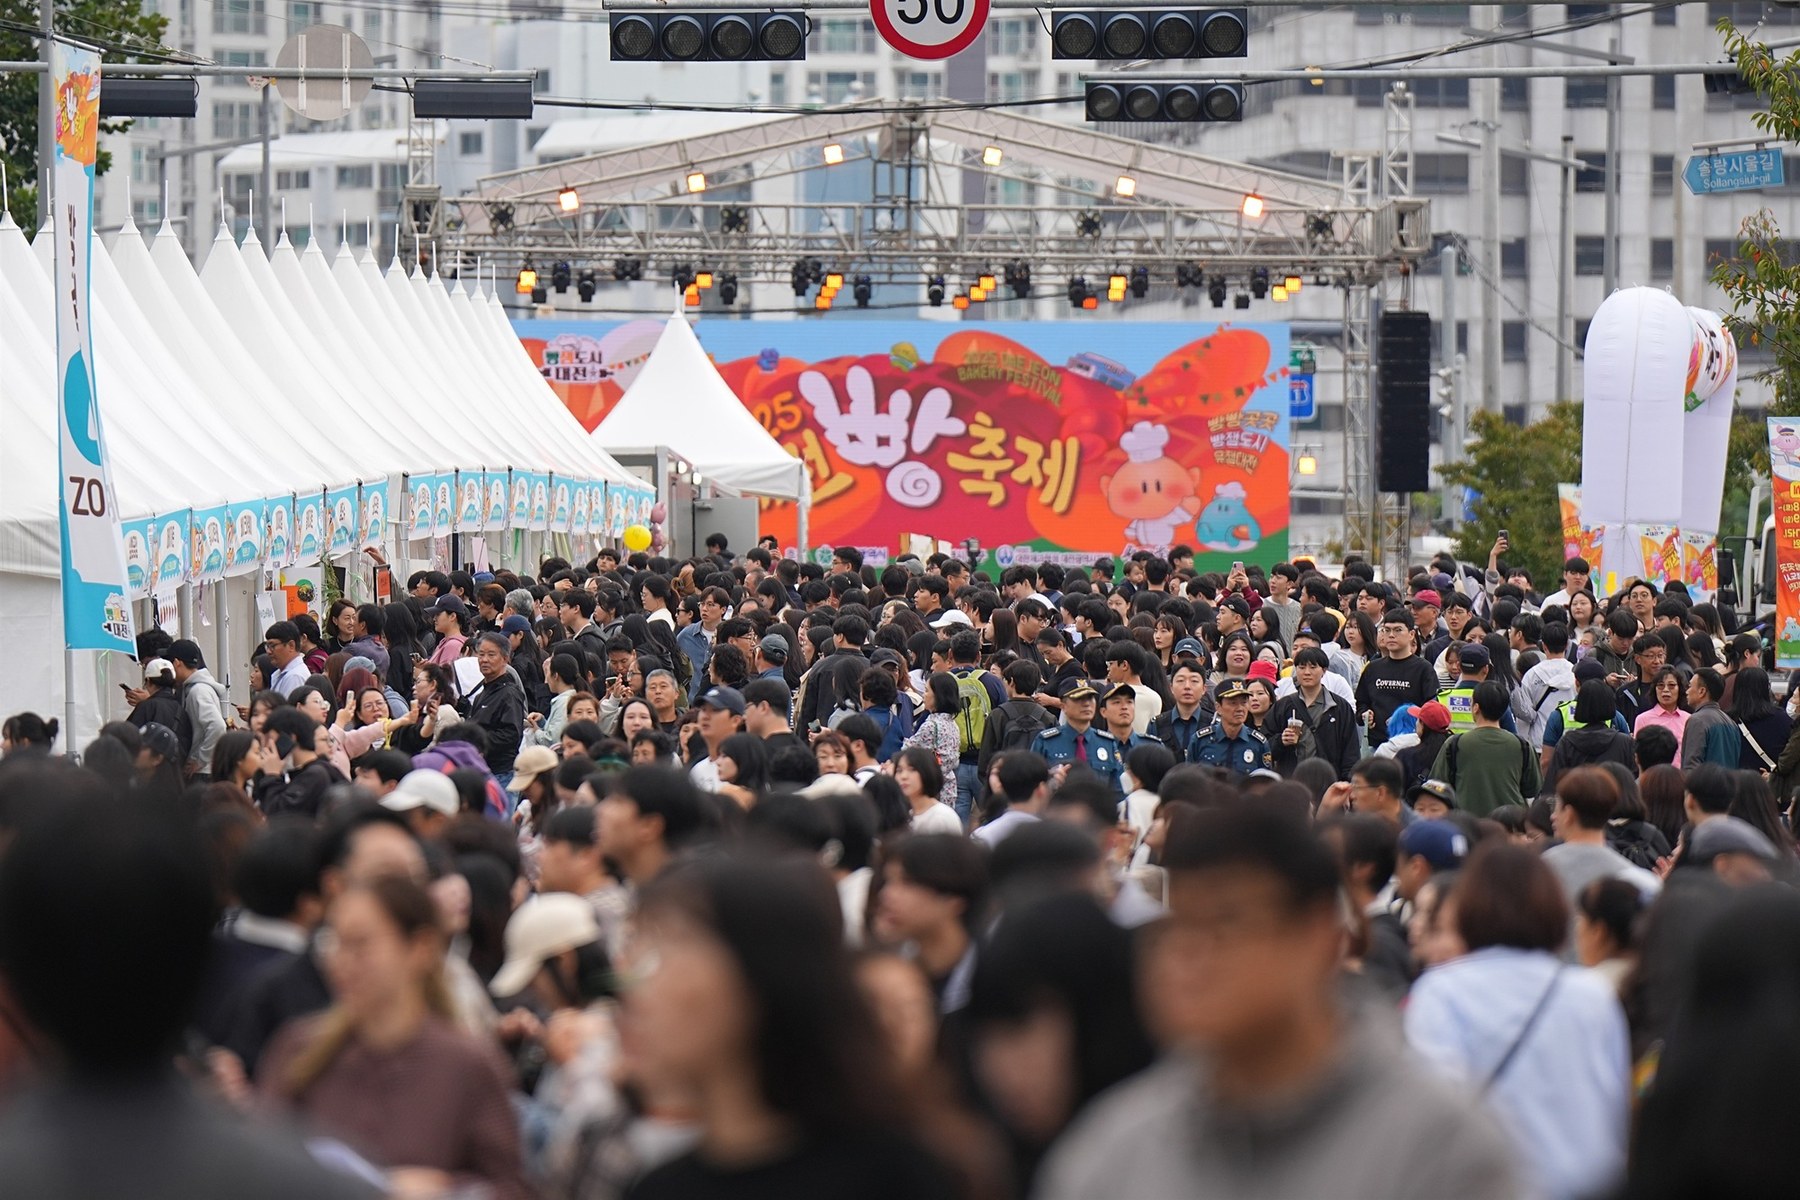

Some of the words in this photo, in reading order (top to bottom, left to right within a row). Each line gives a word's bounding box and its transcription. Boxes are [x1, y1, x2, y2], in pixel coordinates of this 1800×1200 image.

[897, 0, 965, 25] 50
[1697, 152, 1774, 178] 솔랑시울길
[1703, 173, 1771, 190] Sollangsiul-gil
[555, 366, 587, 381] 대전
[1006, 367, 1062, 407] FESTIVAL
[798, 365, 967, 508] 빵
[946, 411, 1080, 513] 축제
